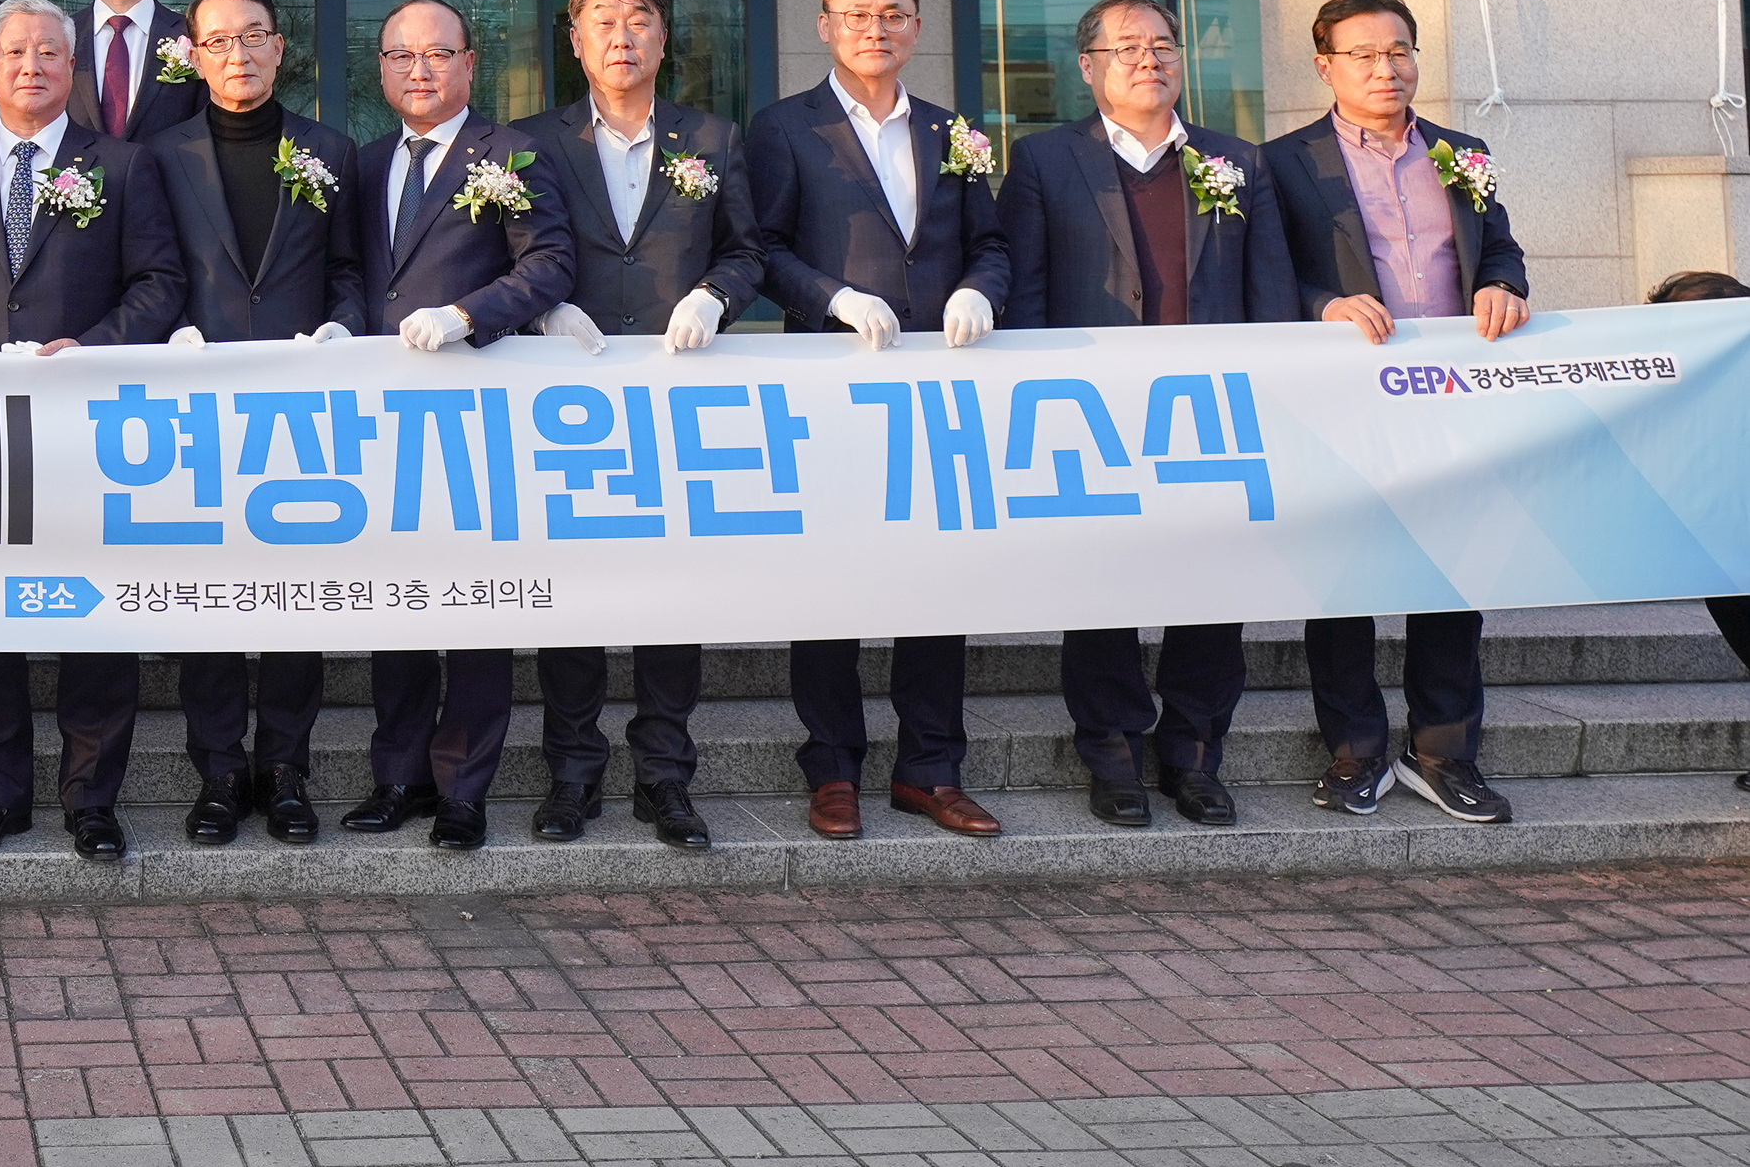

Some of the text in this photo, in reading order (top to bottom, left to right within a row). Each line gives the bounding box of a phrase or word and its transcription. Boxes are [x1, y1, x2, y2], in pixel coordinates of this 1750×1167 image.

[1379, 357, 1676, 396] GEPA 경상북도경제진흥원
[87, 383, 811, 546] 현장지원단
[849, 372, 1275, 531] 개소식
[17, 578, 553, 612] 장소 경상북도경제진흥원 3층 소회의실
